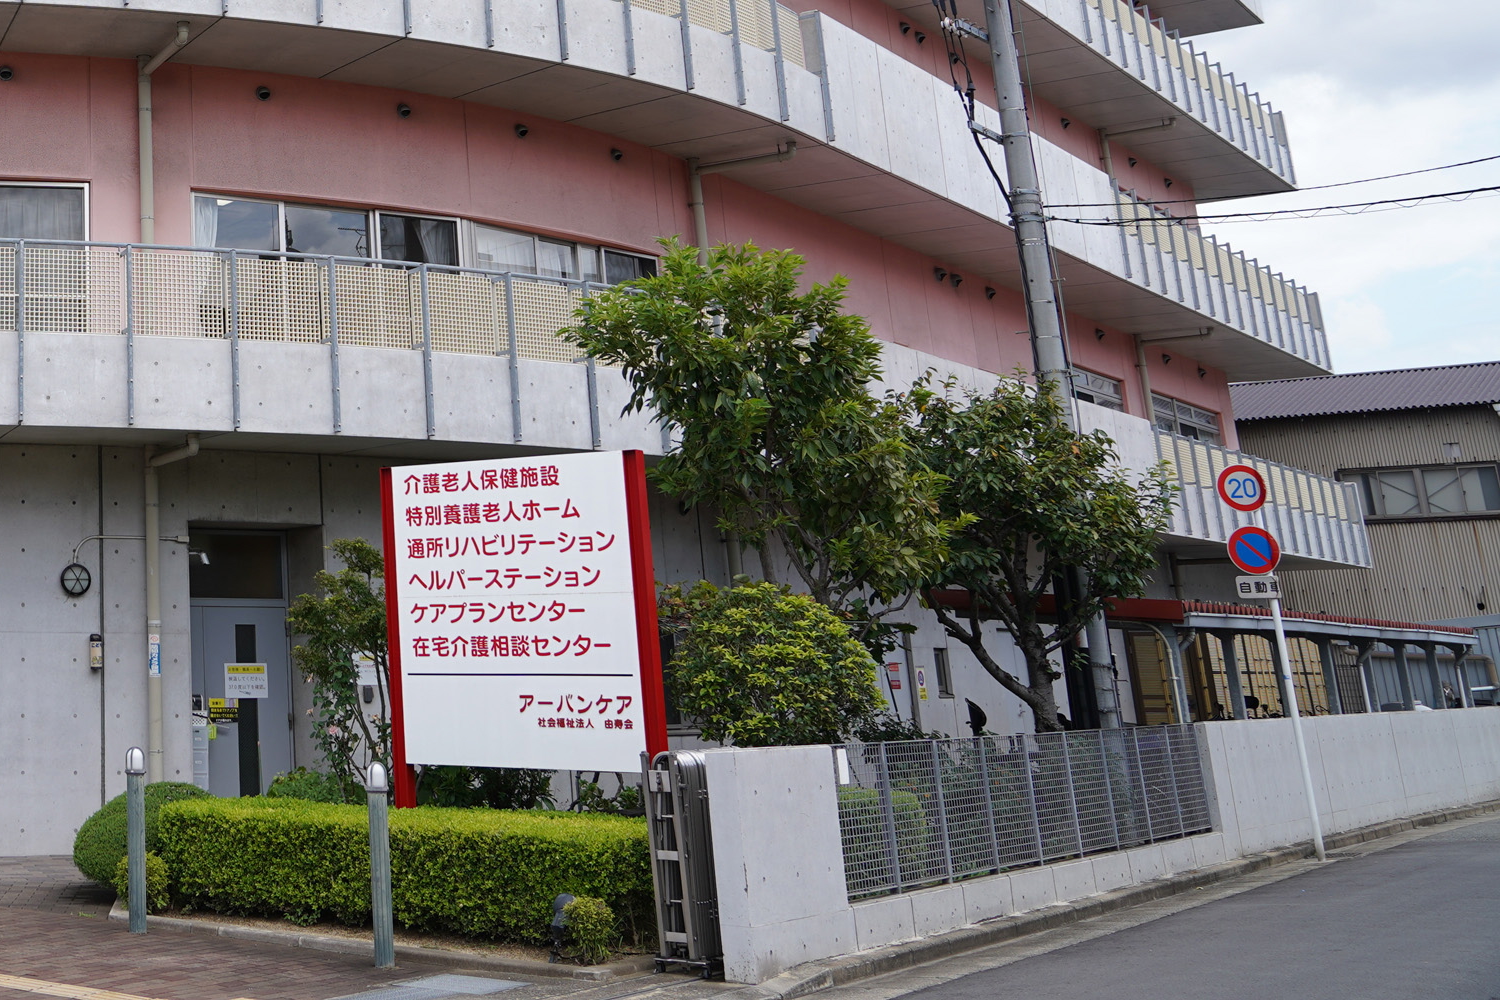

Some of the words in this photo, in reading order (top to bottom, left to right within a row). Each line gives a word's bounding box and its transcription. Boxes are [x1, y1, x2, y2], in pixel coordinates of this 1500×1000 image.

[404, 465, 560, 495] 介護老人保健施設
[1227, 478, 1258, 499] 20
[405, 498, 581, 527] 特別養護老人ホーム
[407, 531, 615, 559] 通所リハビリテーション
[409, 566, 601, 590] ヘルパーステーション
[1240, 581, 1279, 594] 自動車
[410, 600, 586, 624] ケアプランセンター
[412, 634, 612, 658] 在宅介護相談センター
[519, 694, 633, 715] アーバンケア
[537, 717, 594, 729] 社会福祉法人
